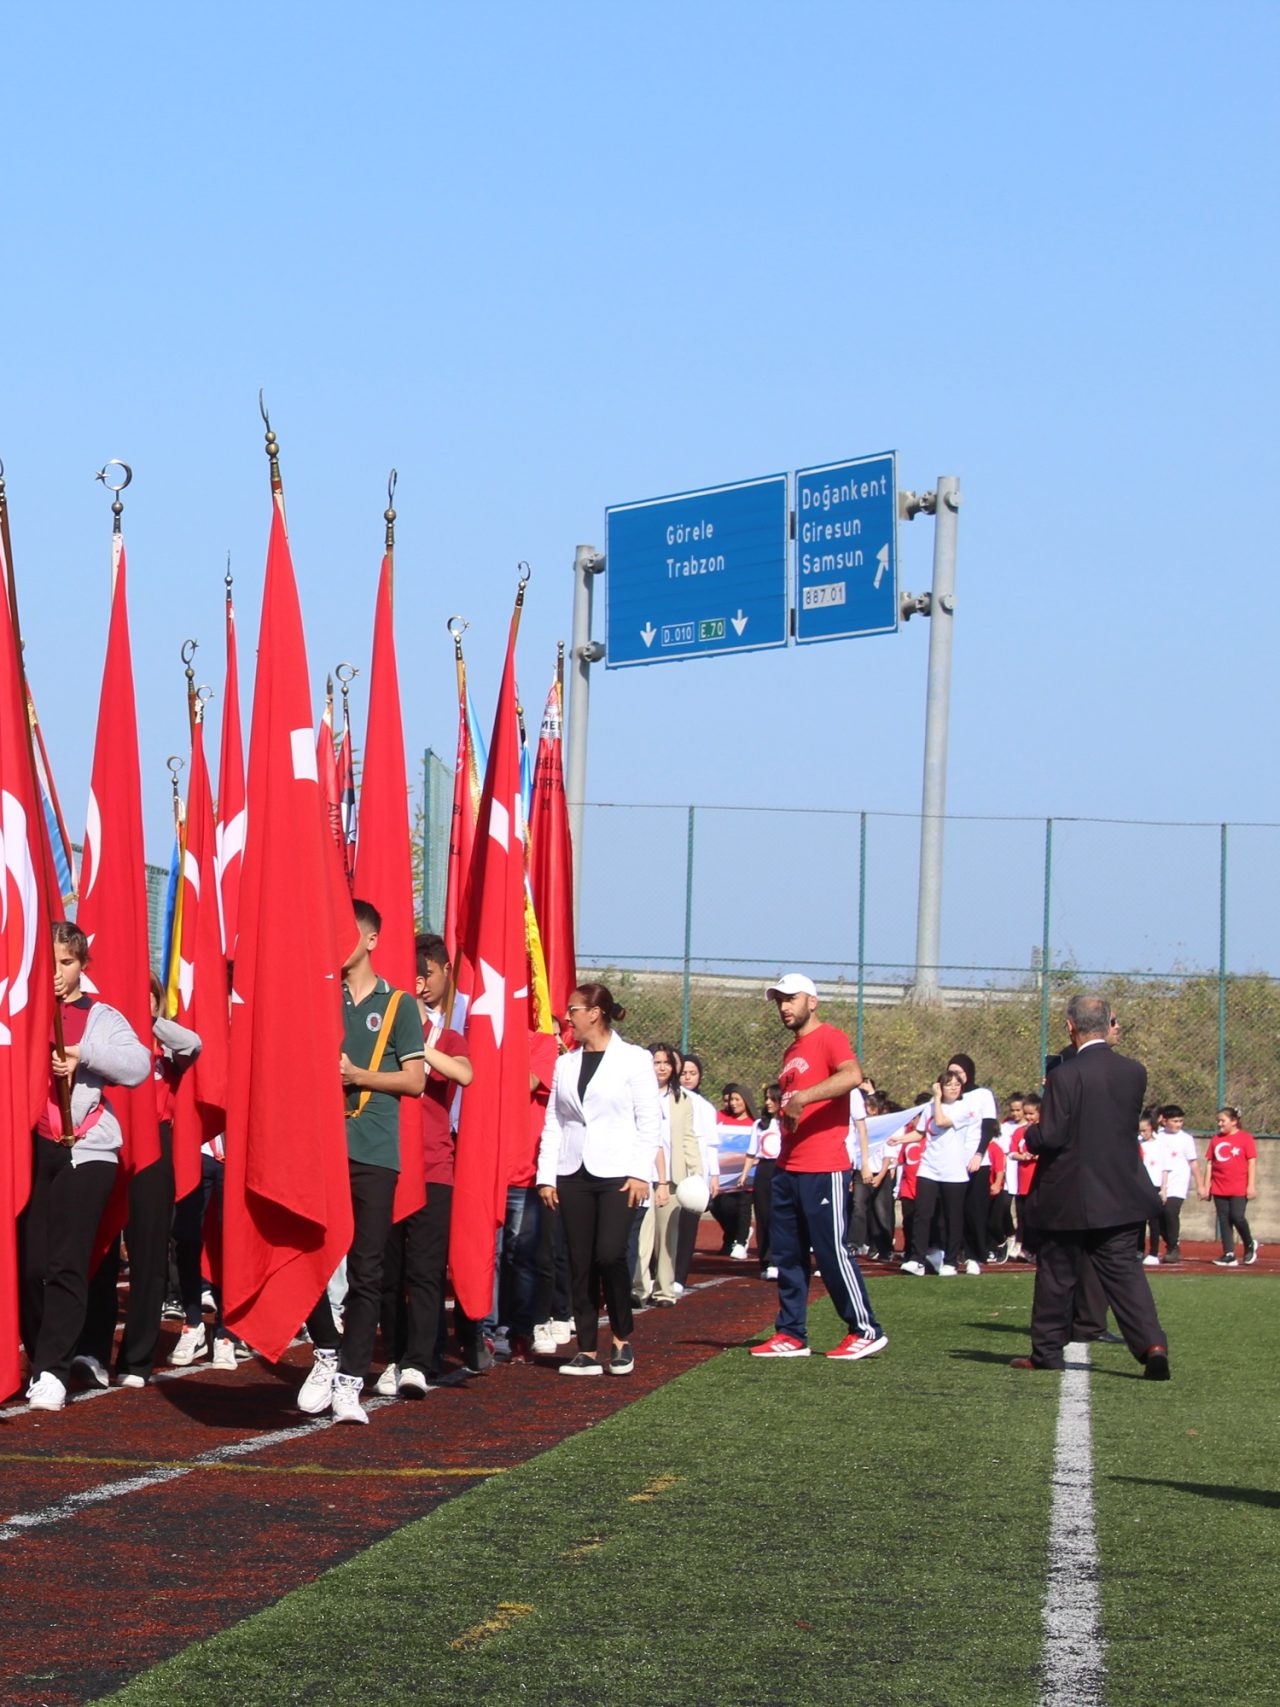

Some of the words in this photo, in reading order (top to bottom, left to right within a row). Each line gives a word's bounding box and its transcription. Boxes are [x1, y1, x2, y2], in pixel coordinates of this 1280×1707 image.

[802, 475, 887, 510] Doğankent
[666, 519, 713, 545] Görele
[803, 518, 862, 543] Giresun
[666, 554, 725, 578] Trabzon
[803, 548, 864, 575] Samsun
[805, 587, 843, 605] 887.01
[663, 626, 692, 643] D.010
[701, 622, 724, 639] E.70
